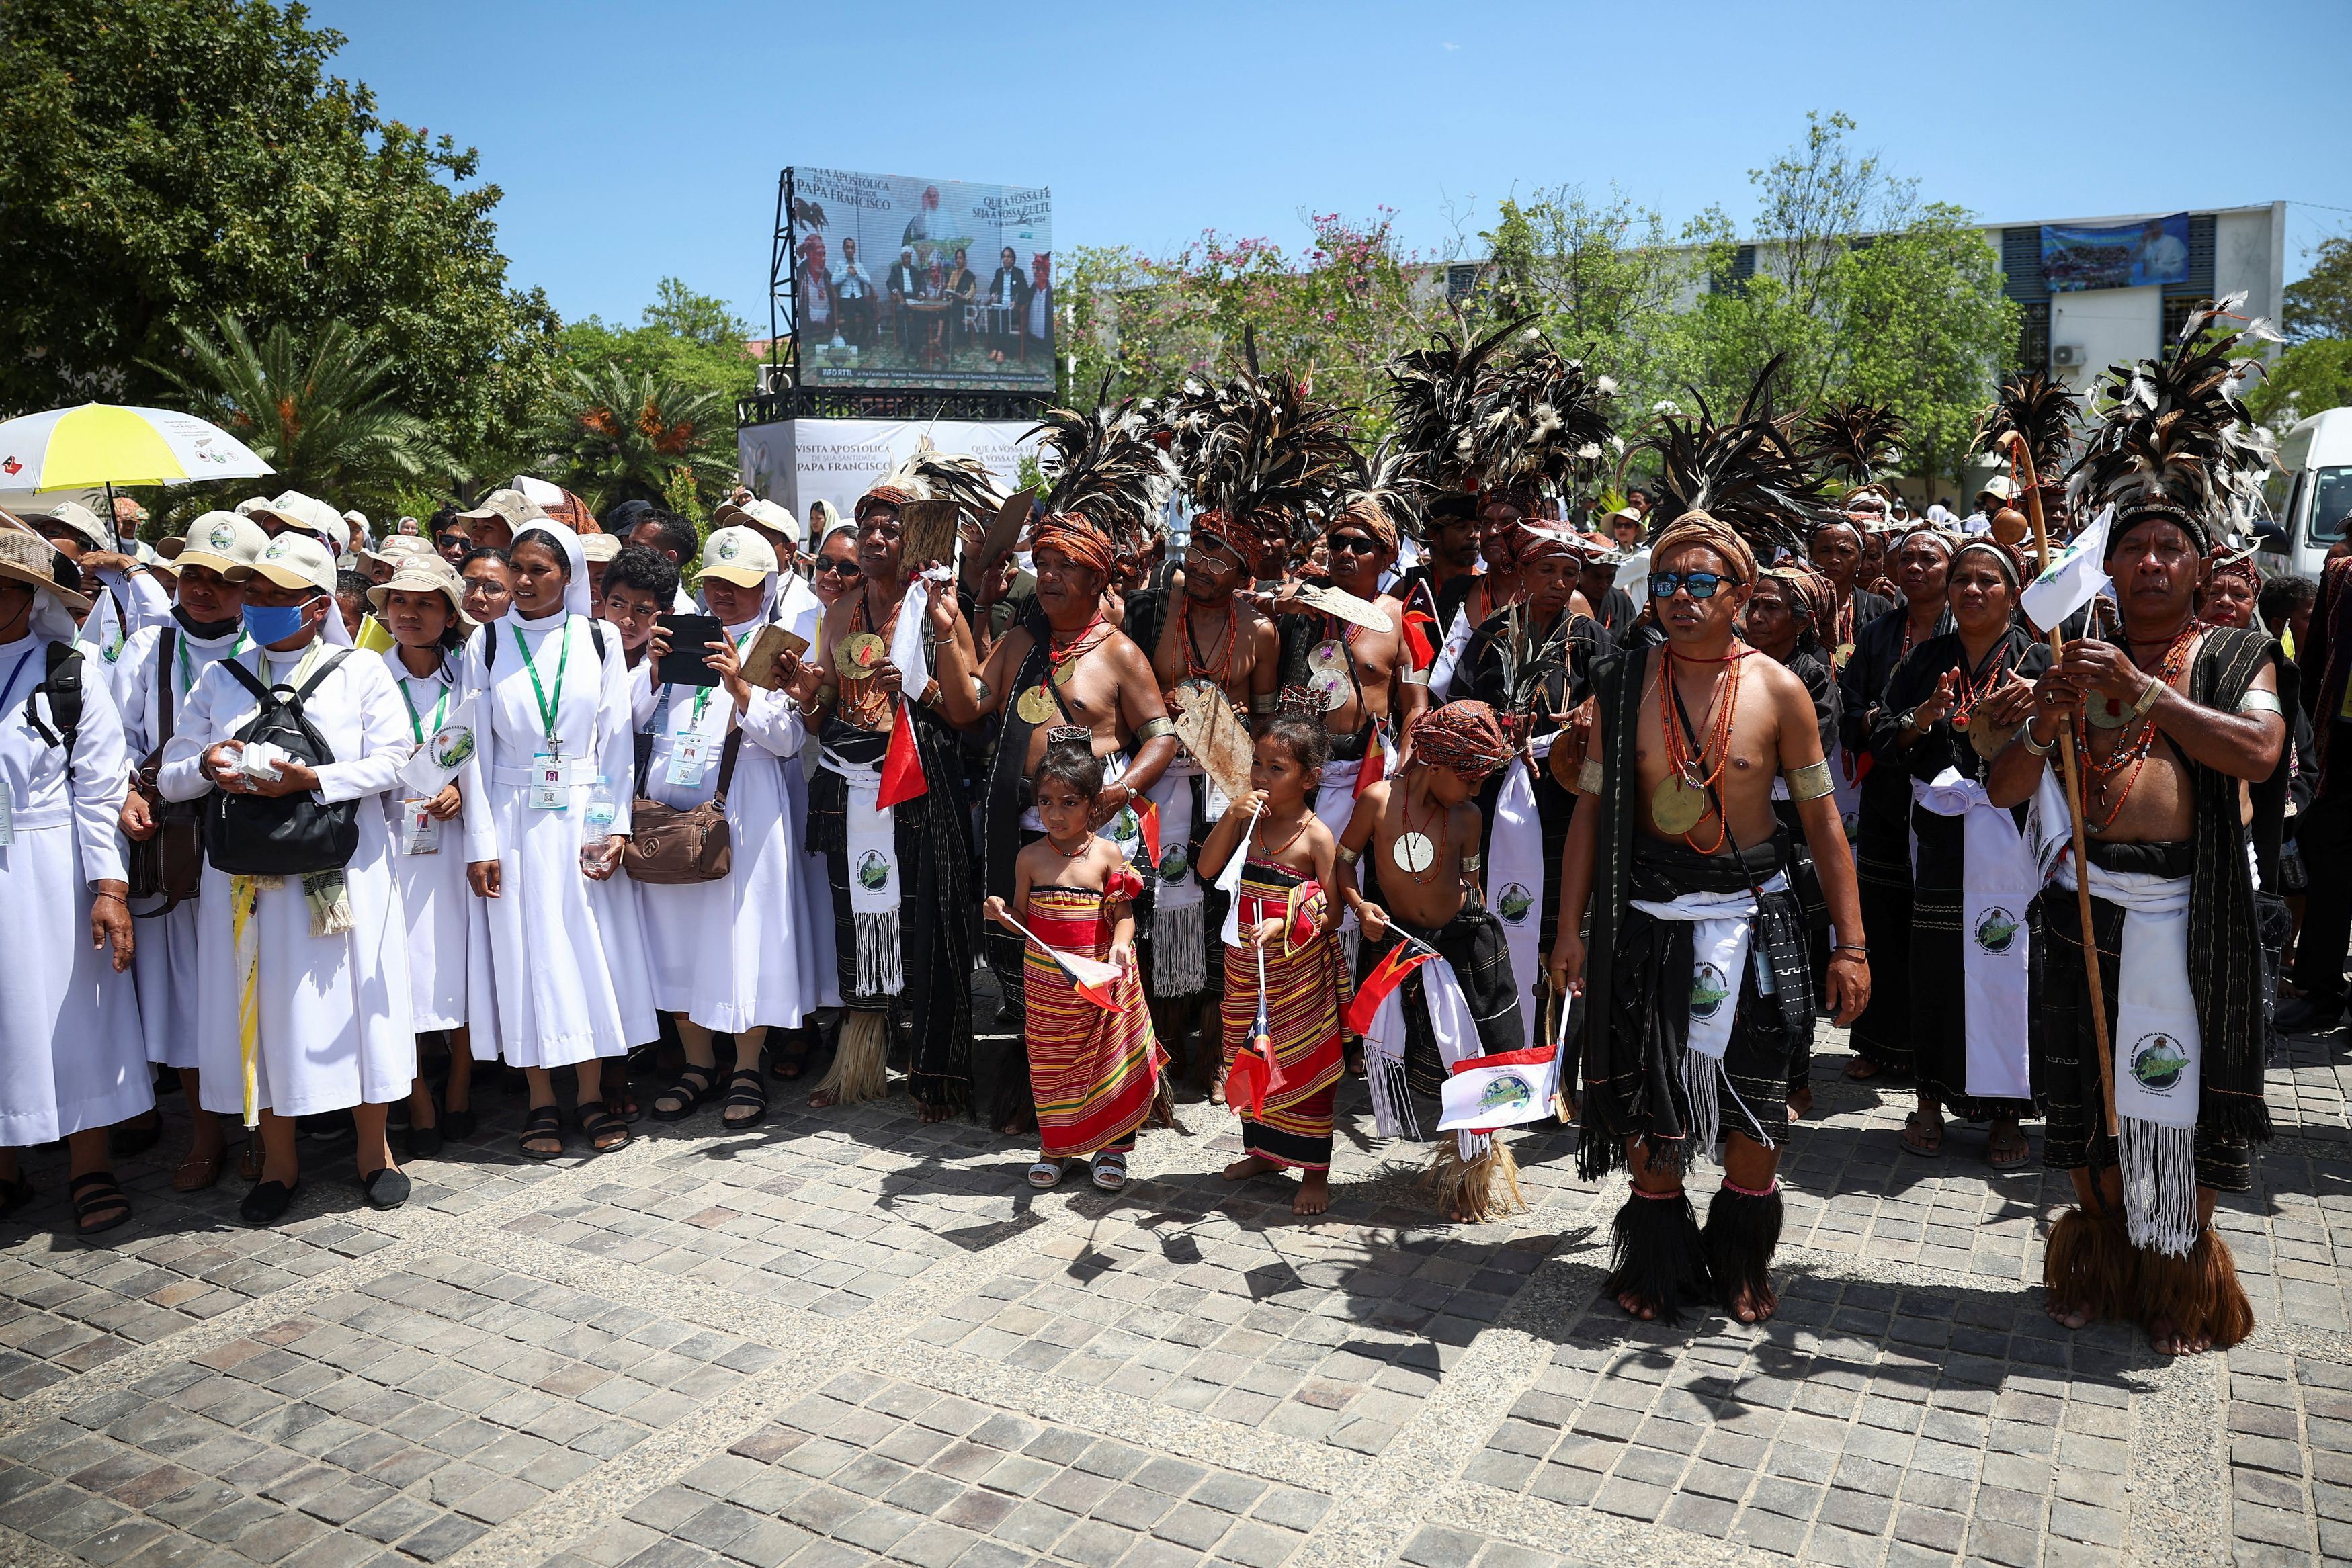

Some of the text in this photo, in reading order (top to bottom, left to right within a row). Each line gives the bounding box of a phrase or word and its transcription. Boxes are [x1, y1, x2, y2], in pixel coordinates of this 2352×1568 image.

[797, 179, 890, 210] PAPA FRANCISCO
[984, 196, 1002, 210] QUE
[1004, 198, 1009, 206] A
[1010, 191, 1038, 204] VOSSA
[972, 207, 991, 218] SEJA
[991, 210, 996, 218] A
[822, 368, 853, 376] INFO RTTL
[796, 443, 827, 453] VISITA
[971, 445, 988, 455] QUE
[999, 444, 1023, 453] VOSSA
[986, 454, 1011, 462] VOSSA
[797, 462, 890, 472] PAPA FRANCISCO
[437, 726, 452, 734] VOSSA
[2173, 1038, 2185, 1055] CULTURA
